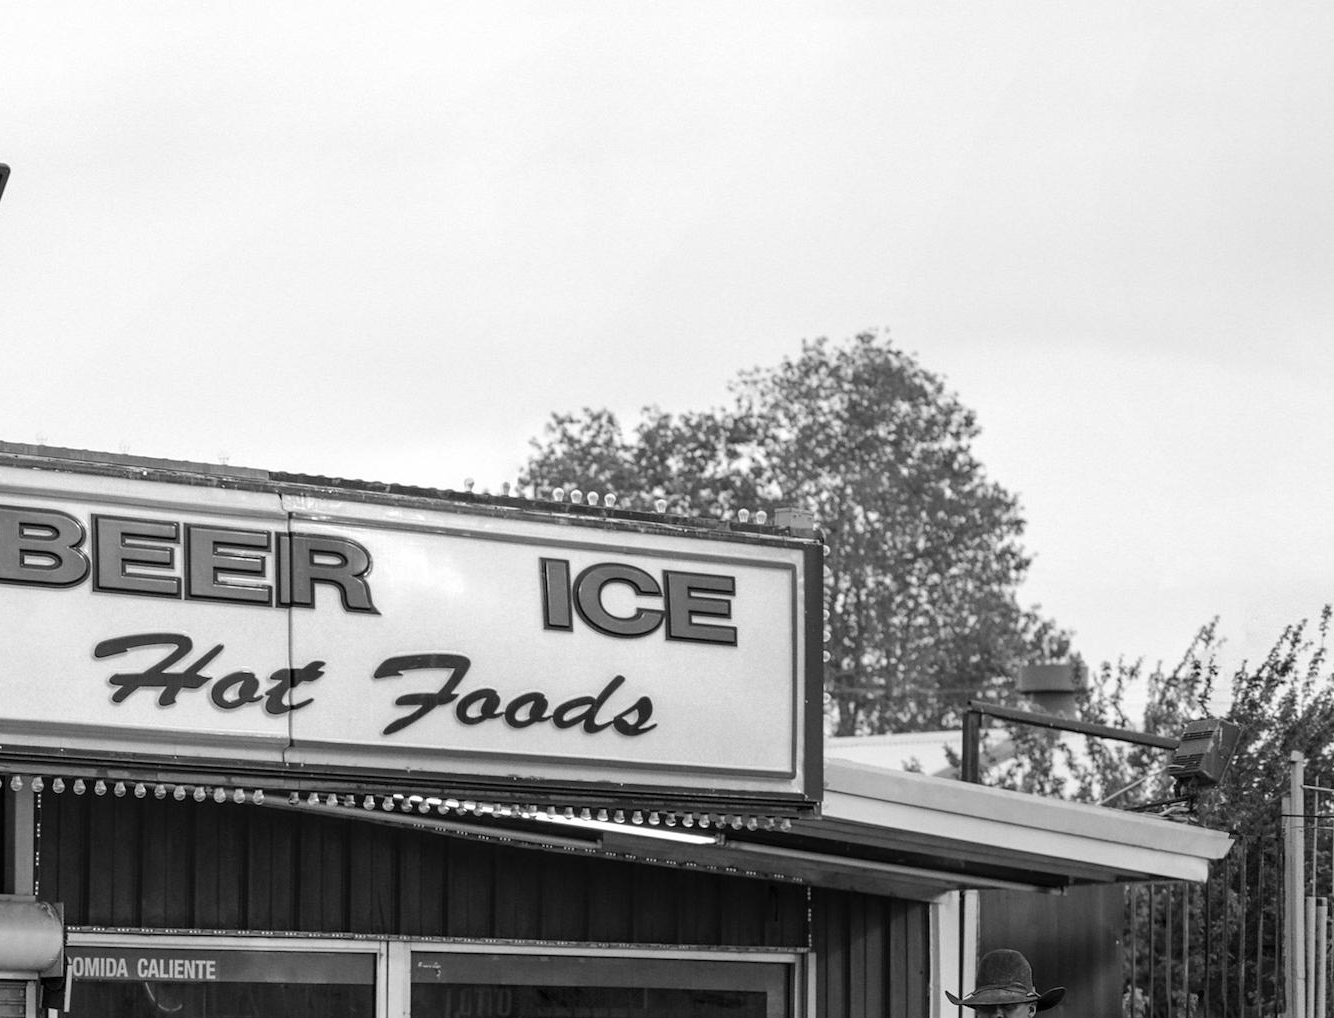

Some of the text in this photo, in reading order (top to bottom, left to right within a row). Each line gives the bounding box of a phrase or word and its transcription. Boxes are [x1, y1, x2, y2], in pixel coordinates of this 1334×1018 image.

[539, 556, 738, 647] ICE
[94, 632, 659, 738] Hot Foods
[67, 956, 217, 979] OMIDA CALIENTE
